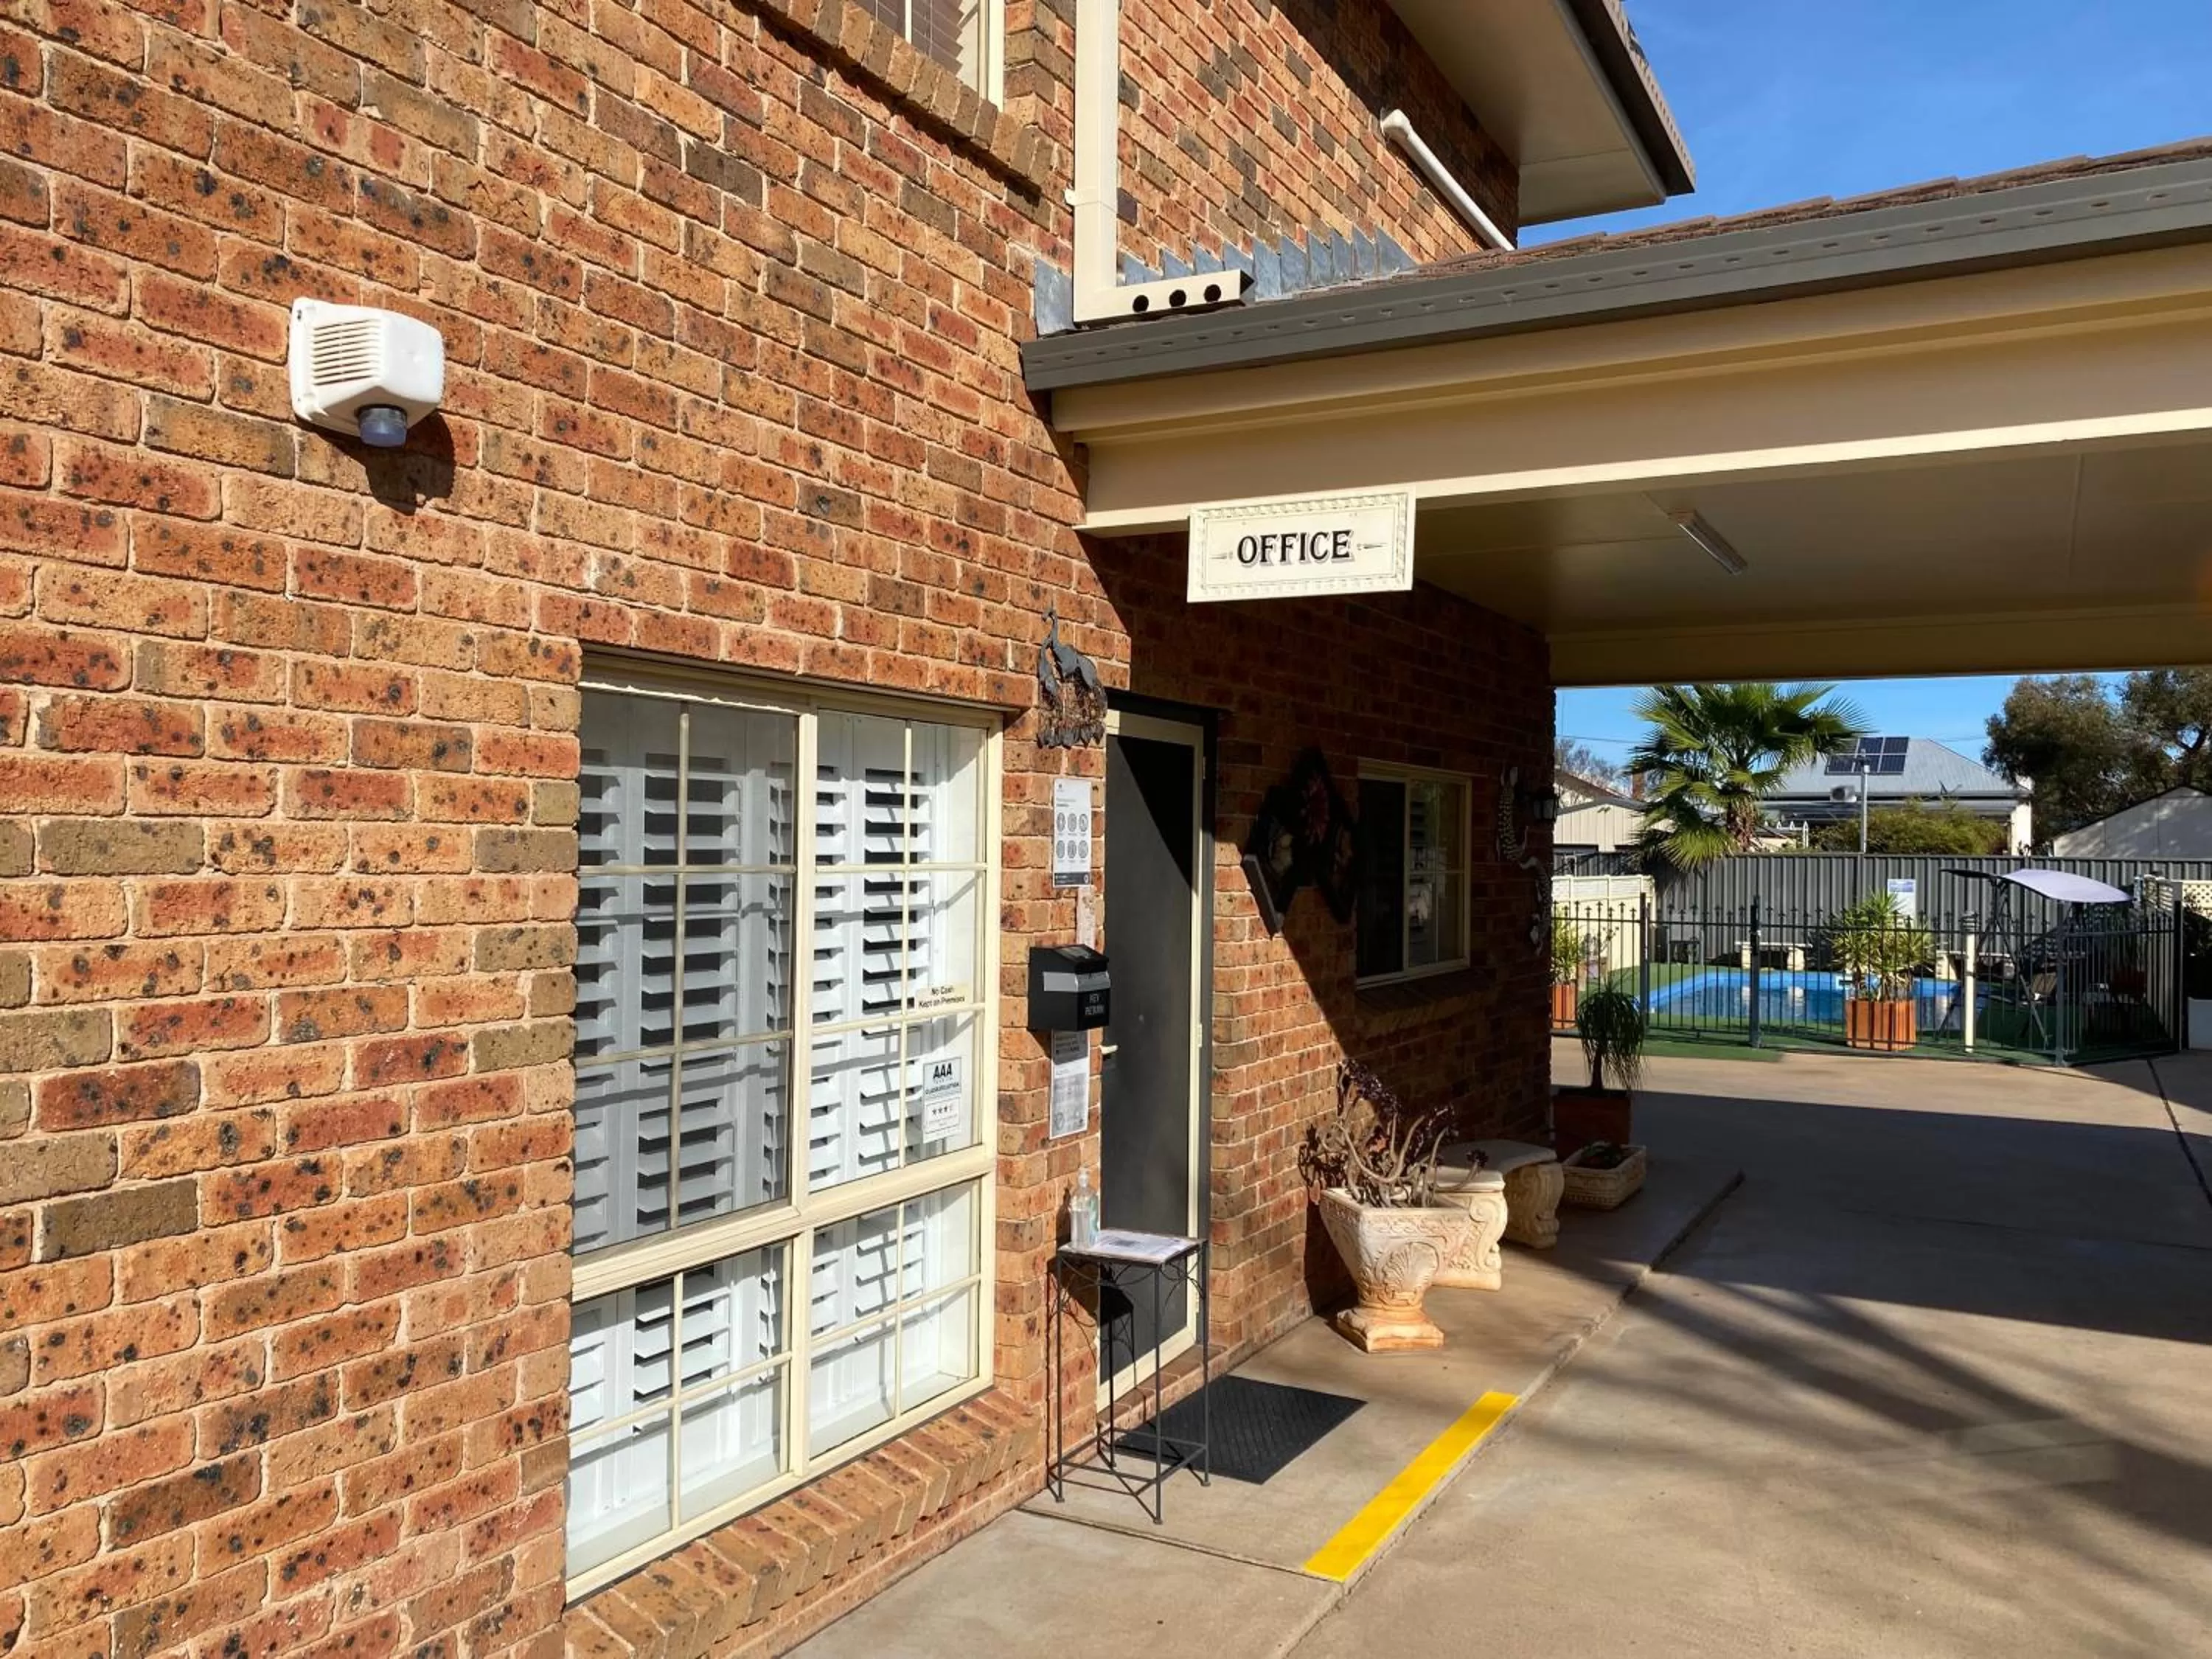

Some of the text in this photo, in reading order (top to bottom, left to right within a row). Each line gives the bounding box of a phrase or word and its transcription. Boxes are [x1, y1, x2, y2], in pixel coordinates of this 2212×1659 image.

[1237, 529, 1354, 566] OFFICE
[931, 987, 940, 995] No
[919, 1000, 932, 1008] Kept
[933, 1062, 953, 1079] AAA
